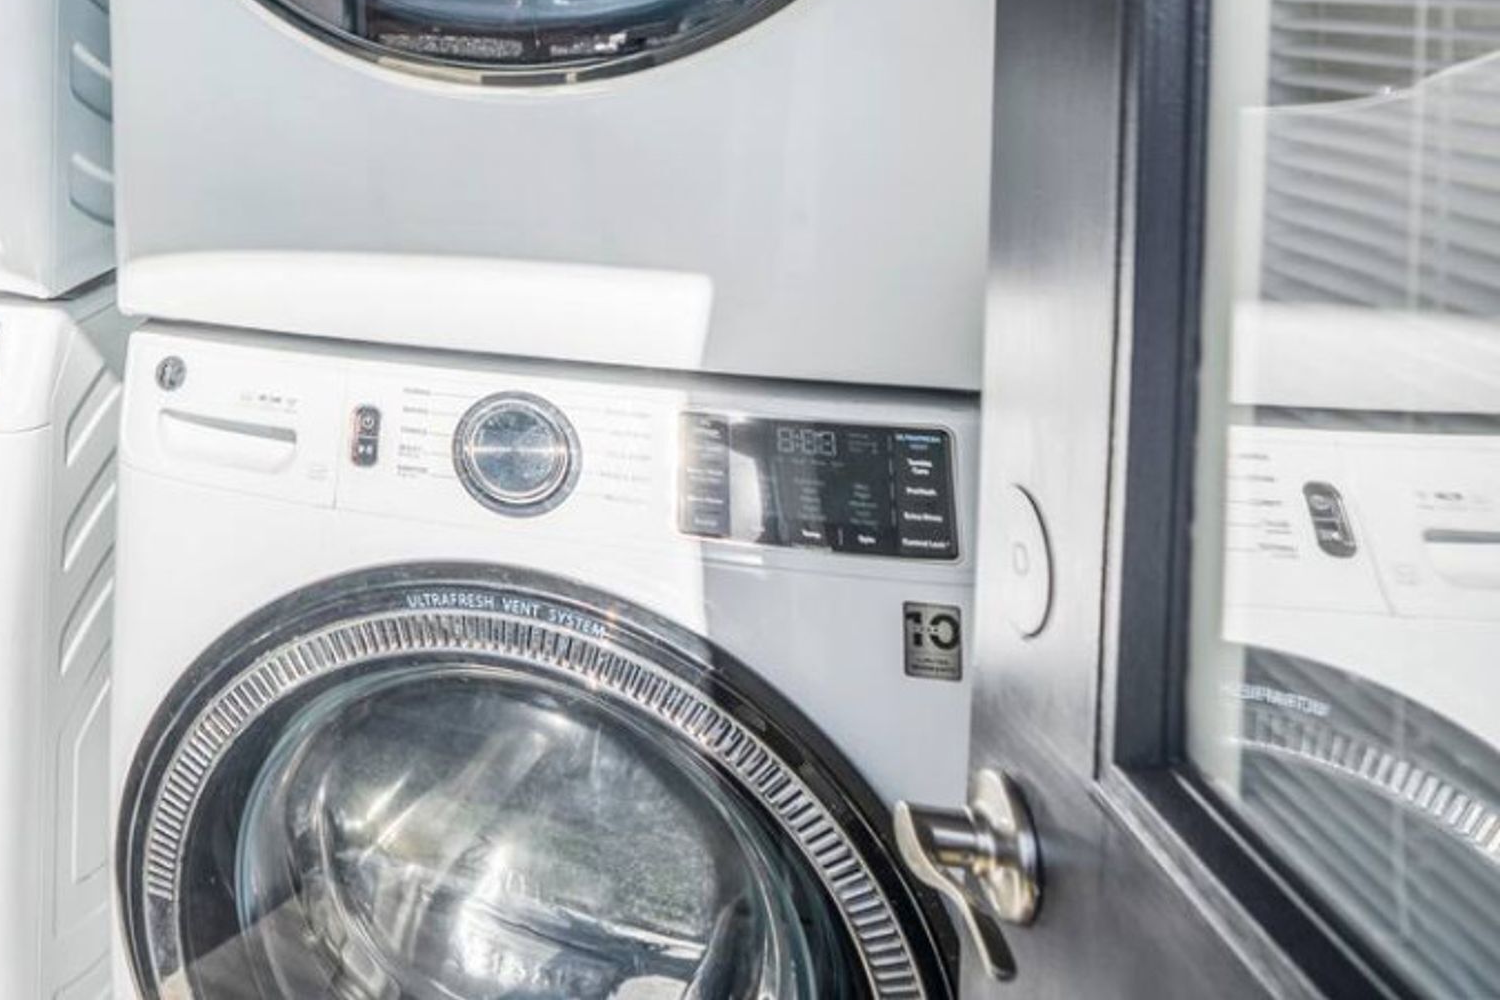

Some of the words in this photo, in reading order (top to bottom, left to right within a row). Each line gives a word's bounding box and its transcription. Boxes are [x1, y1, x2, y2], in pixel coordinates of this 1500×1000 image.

[406, 592, 494, 609] ULTRAFRESH
[501, 597, 540, 617] VENT
[549, 608, 607, 637] SYSTEM
